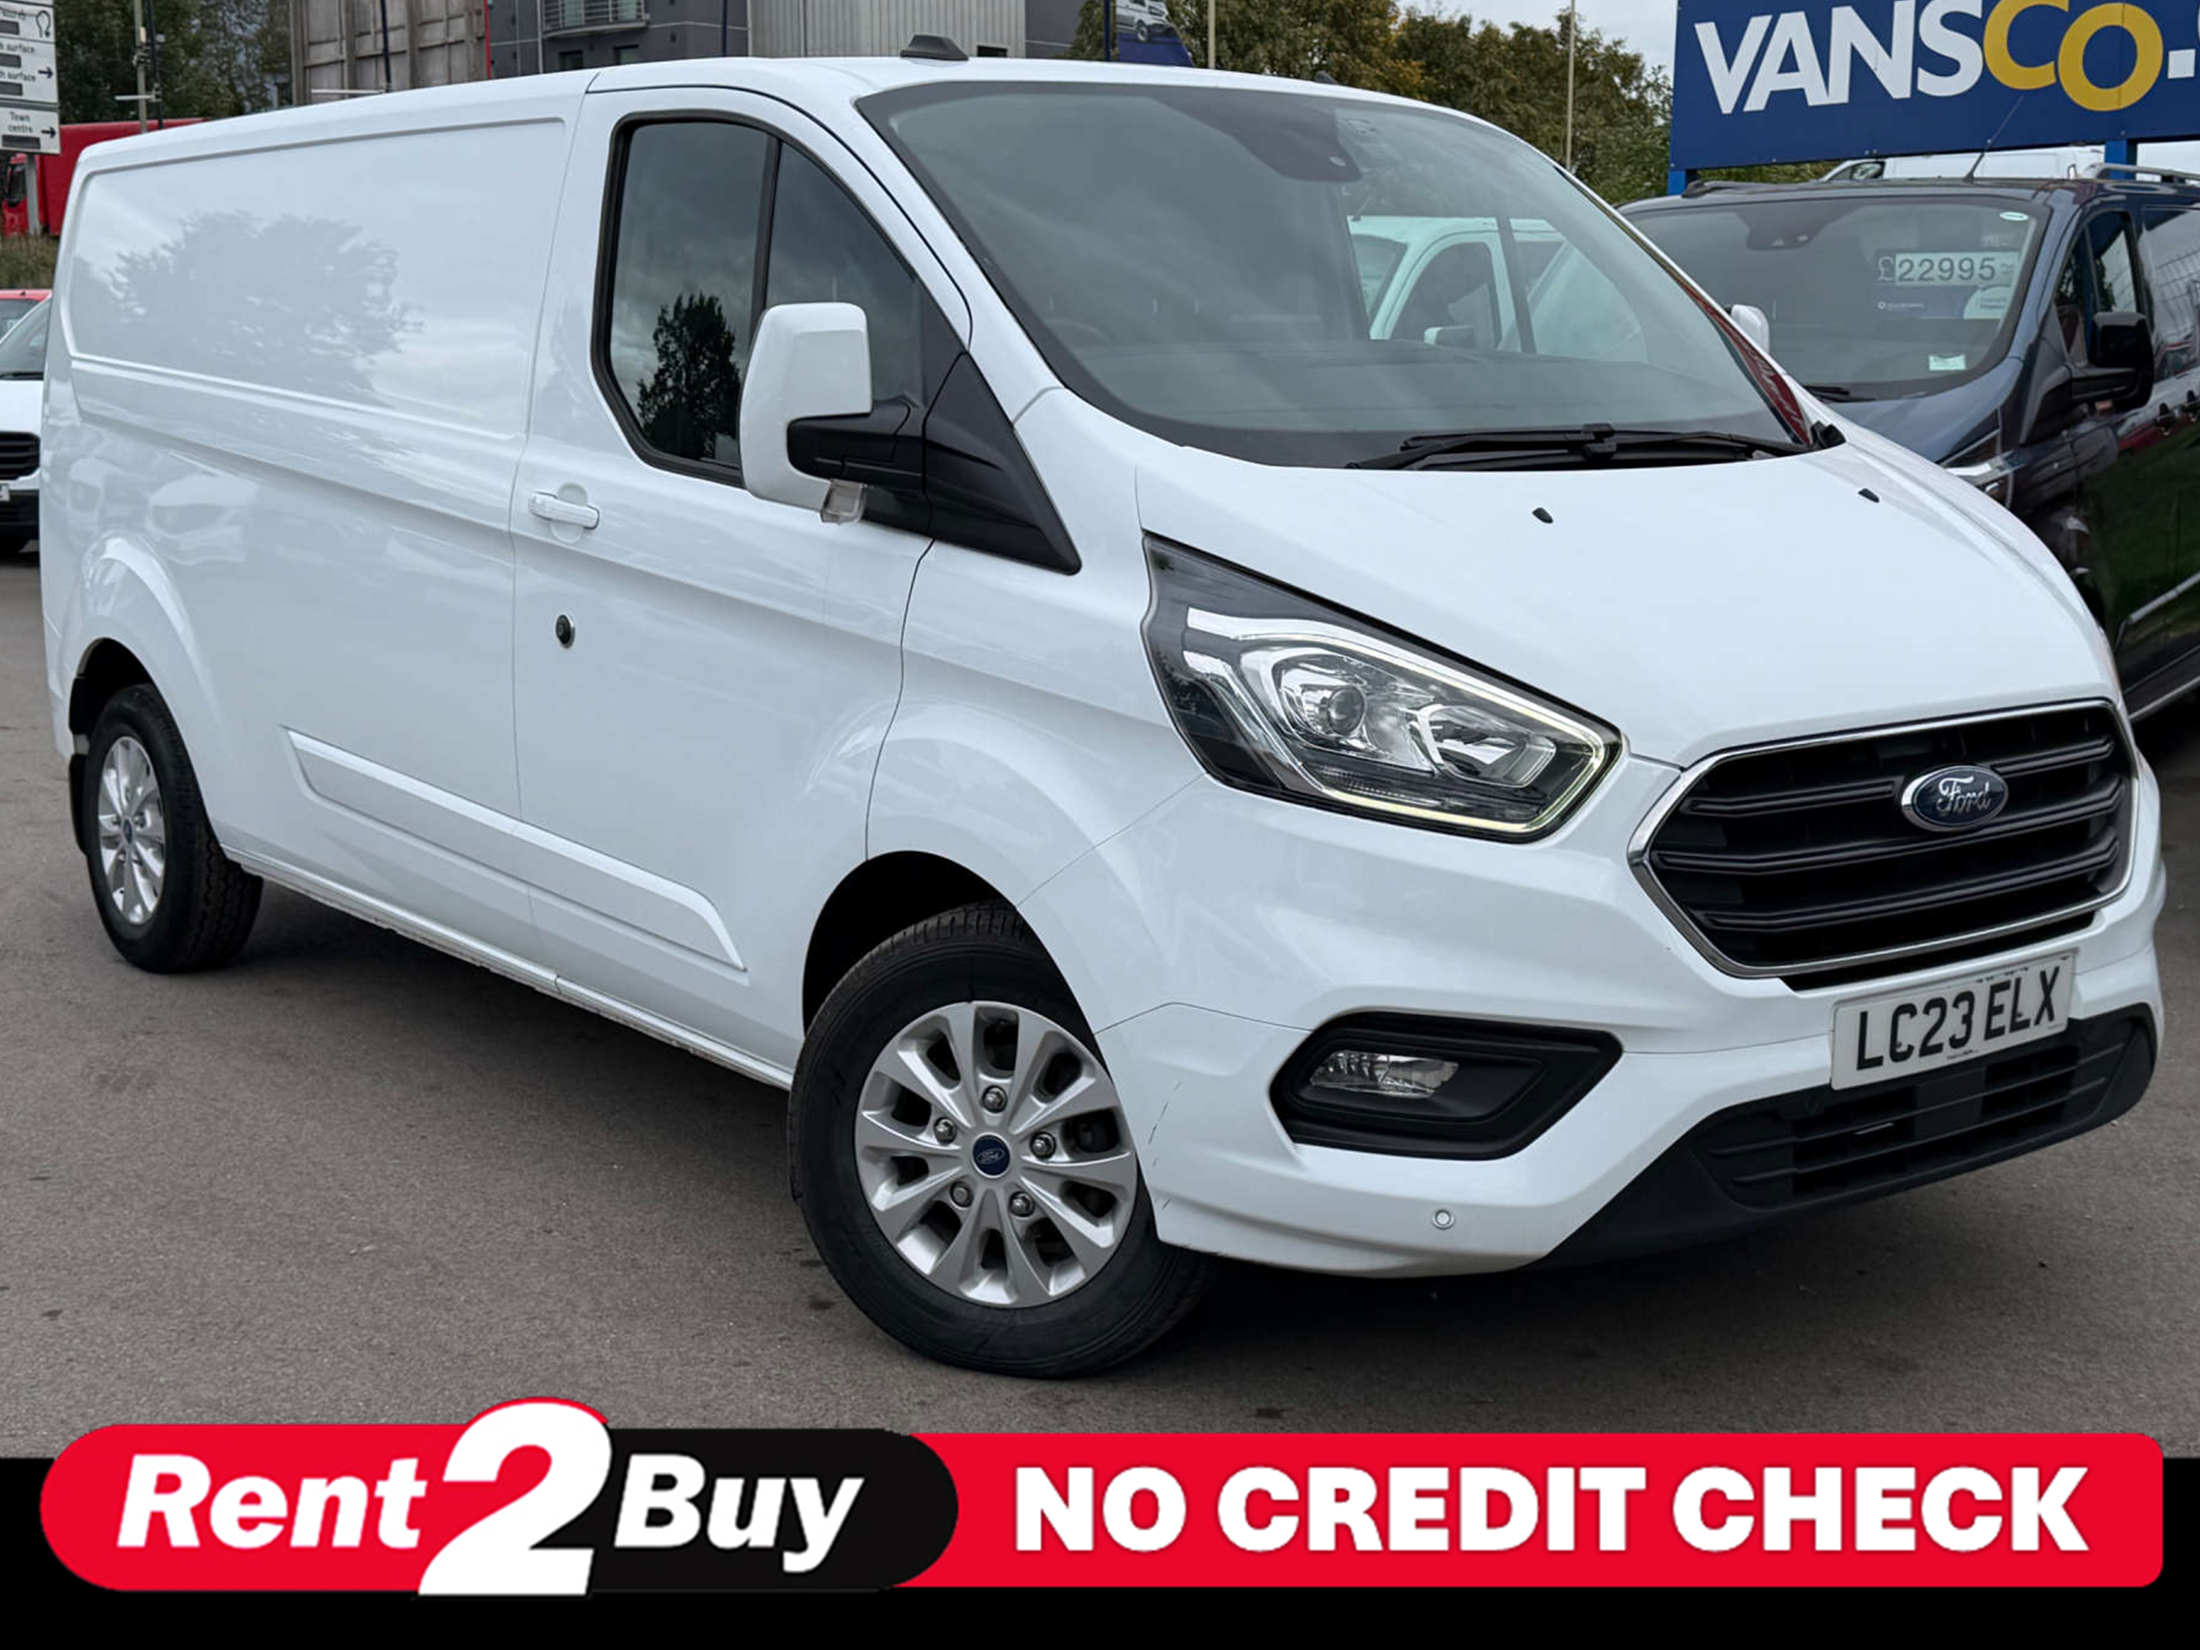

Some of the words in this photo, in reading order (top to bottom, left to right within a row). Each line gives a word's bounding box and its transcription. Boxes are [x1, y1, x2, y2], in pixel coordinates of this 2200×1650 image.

[9, 111, 31, 122] Town
[7, 123, 33, 133] centre
[1877, 255, 1996, 282] £22995
[1935, 775, 1992, 815] Ford
